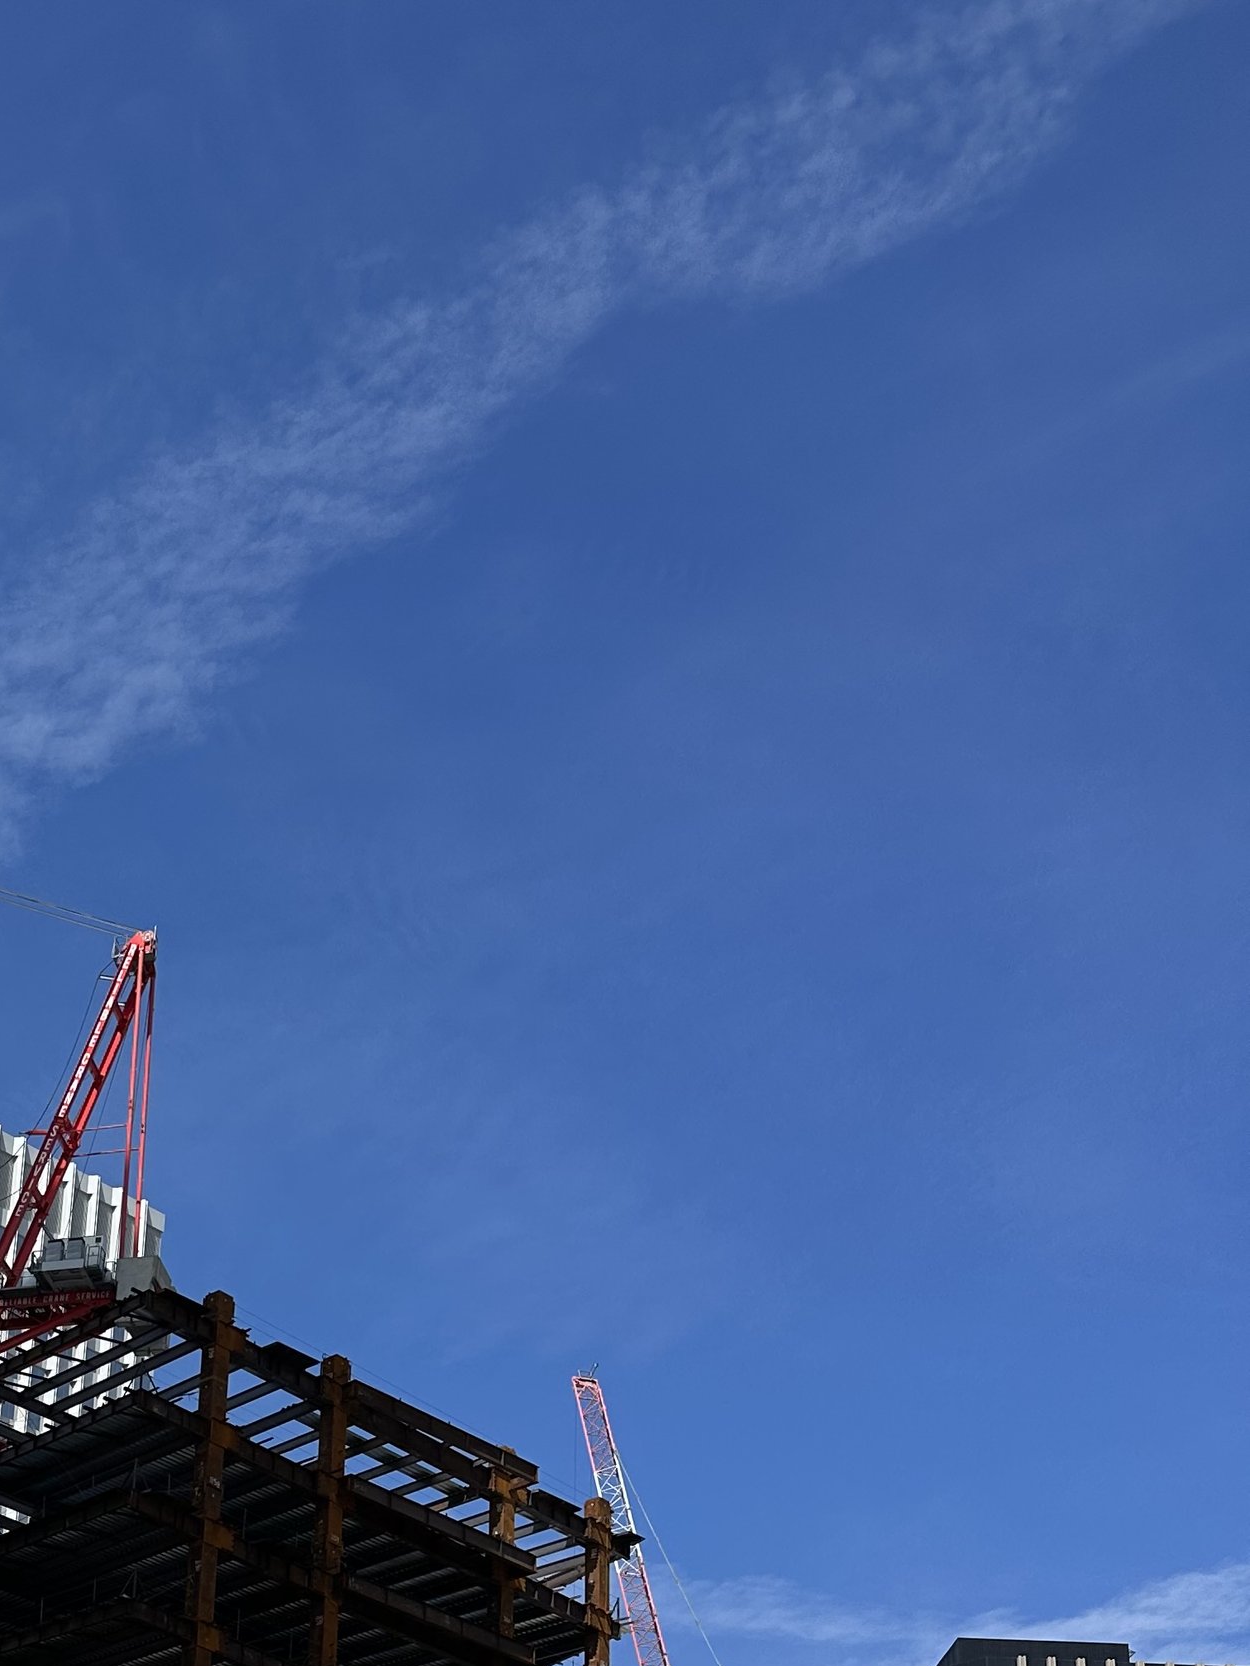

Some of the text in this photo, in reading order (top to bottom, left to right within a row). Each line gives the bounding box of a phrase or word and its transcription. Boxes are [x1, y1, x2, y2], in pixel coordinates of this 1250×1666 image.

[15, 943, 137, 1218] RELIABLE CRANE SERVICE
[42, 1294, 70, 1303] CRANE
[76, 1290, 111, 1301] SERVICE
